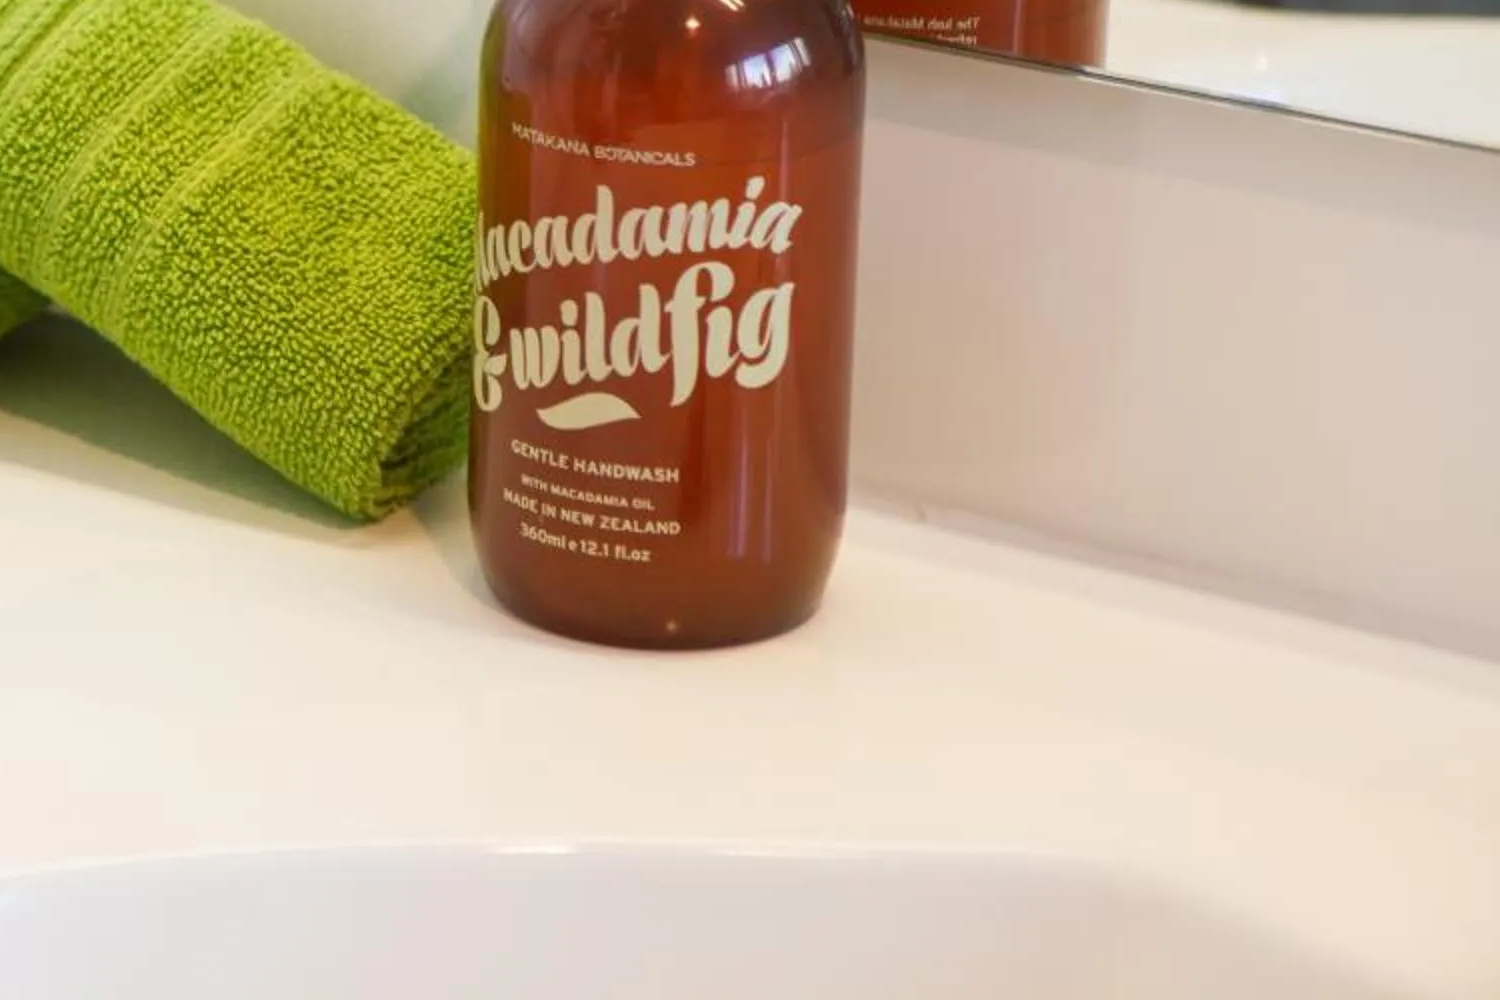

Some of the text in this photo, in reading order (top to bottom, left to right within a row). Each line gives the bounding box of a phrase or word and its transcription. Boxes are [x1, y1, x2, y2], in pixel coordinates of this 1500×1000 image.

[512, 121, 697, 168] MATAKANA BOTANICALS
[511, 438, 681, 484] GENTLE HANDWASH
[503, 487, 682, 536] MADE IN NEW ZEALAND
[520, 473, 656, 512] WITH MACADAMIA OIL
[520, 521, 567, 550] 360ml
[579, 538, 609, 558] 12.1
